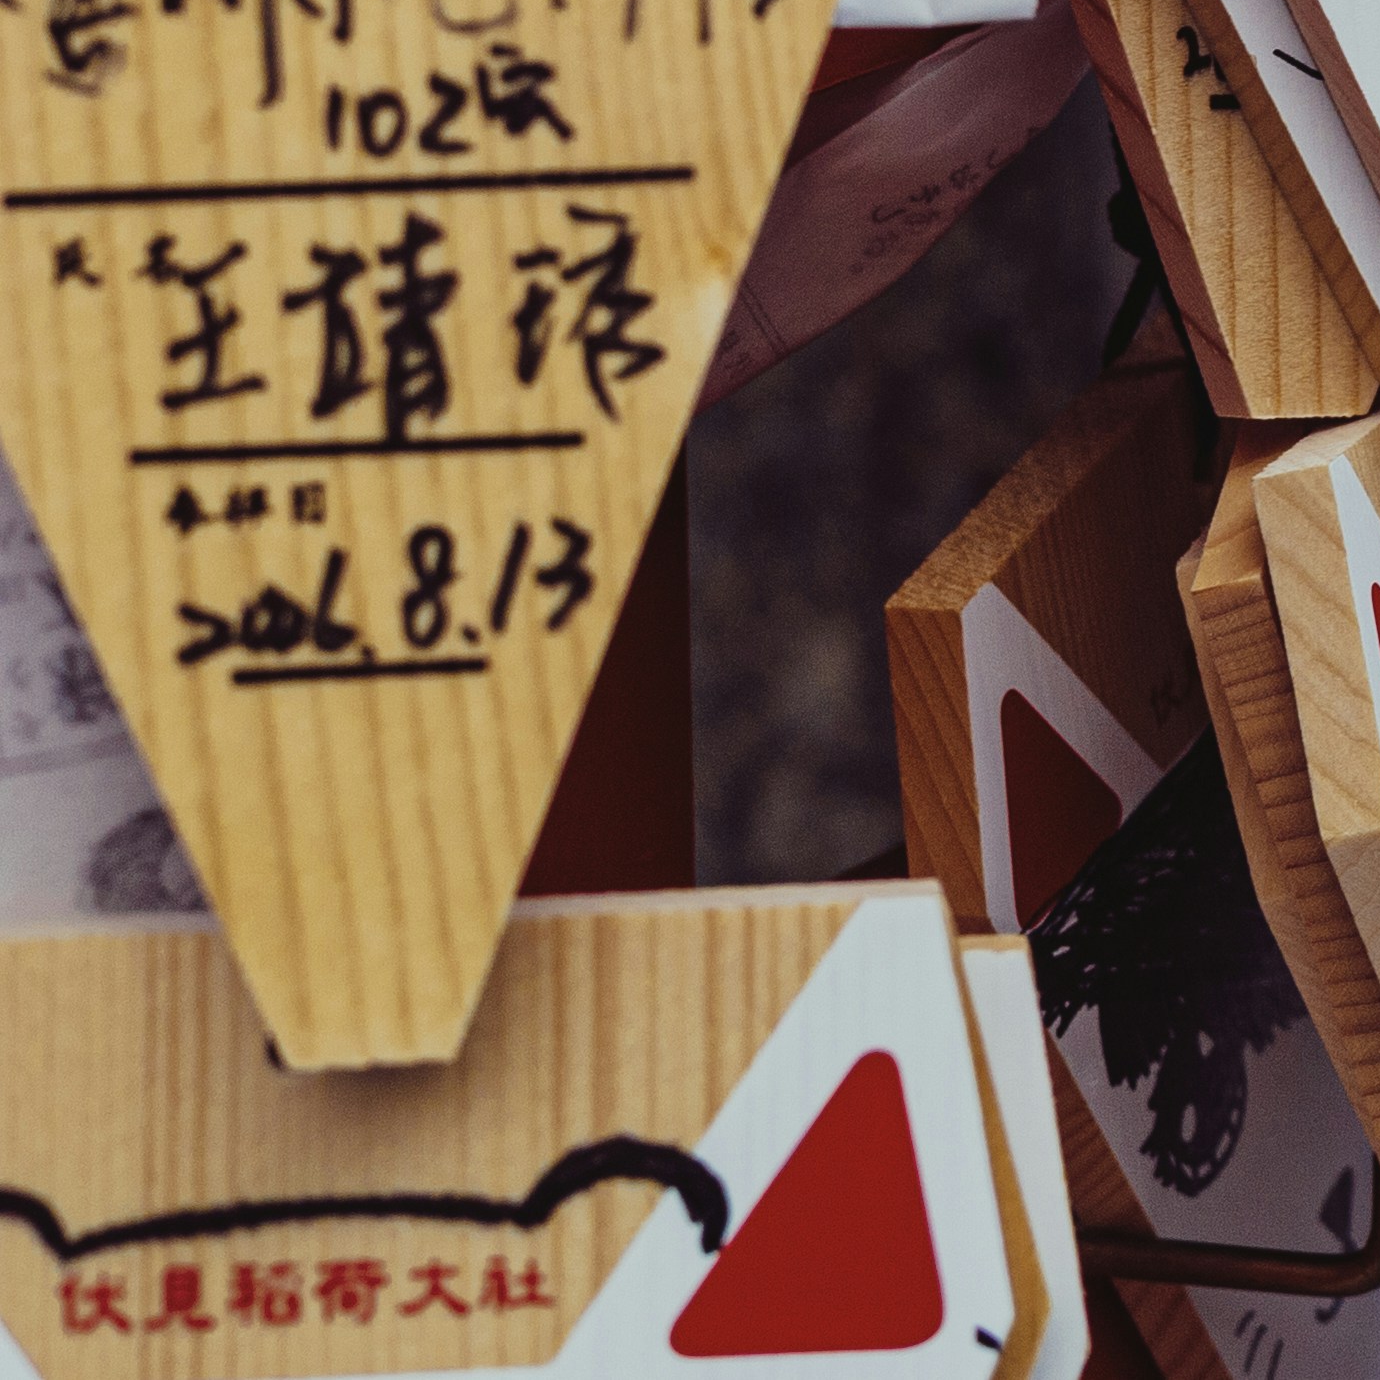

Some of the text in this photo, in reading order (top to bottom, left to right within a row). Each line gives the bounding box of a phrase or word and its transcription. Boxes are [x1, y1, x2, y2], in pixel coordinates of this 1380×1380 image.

[56, 1253, 558, 1337] 伏見稲荷大社
